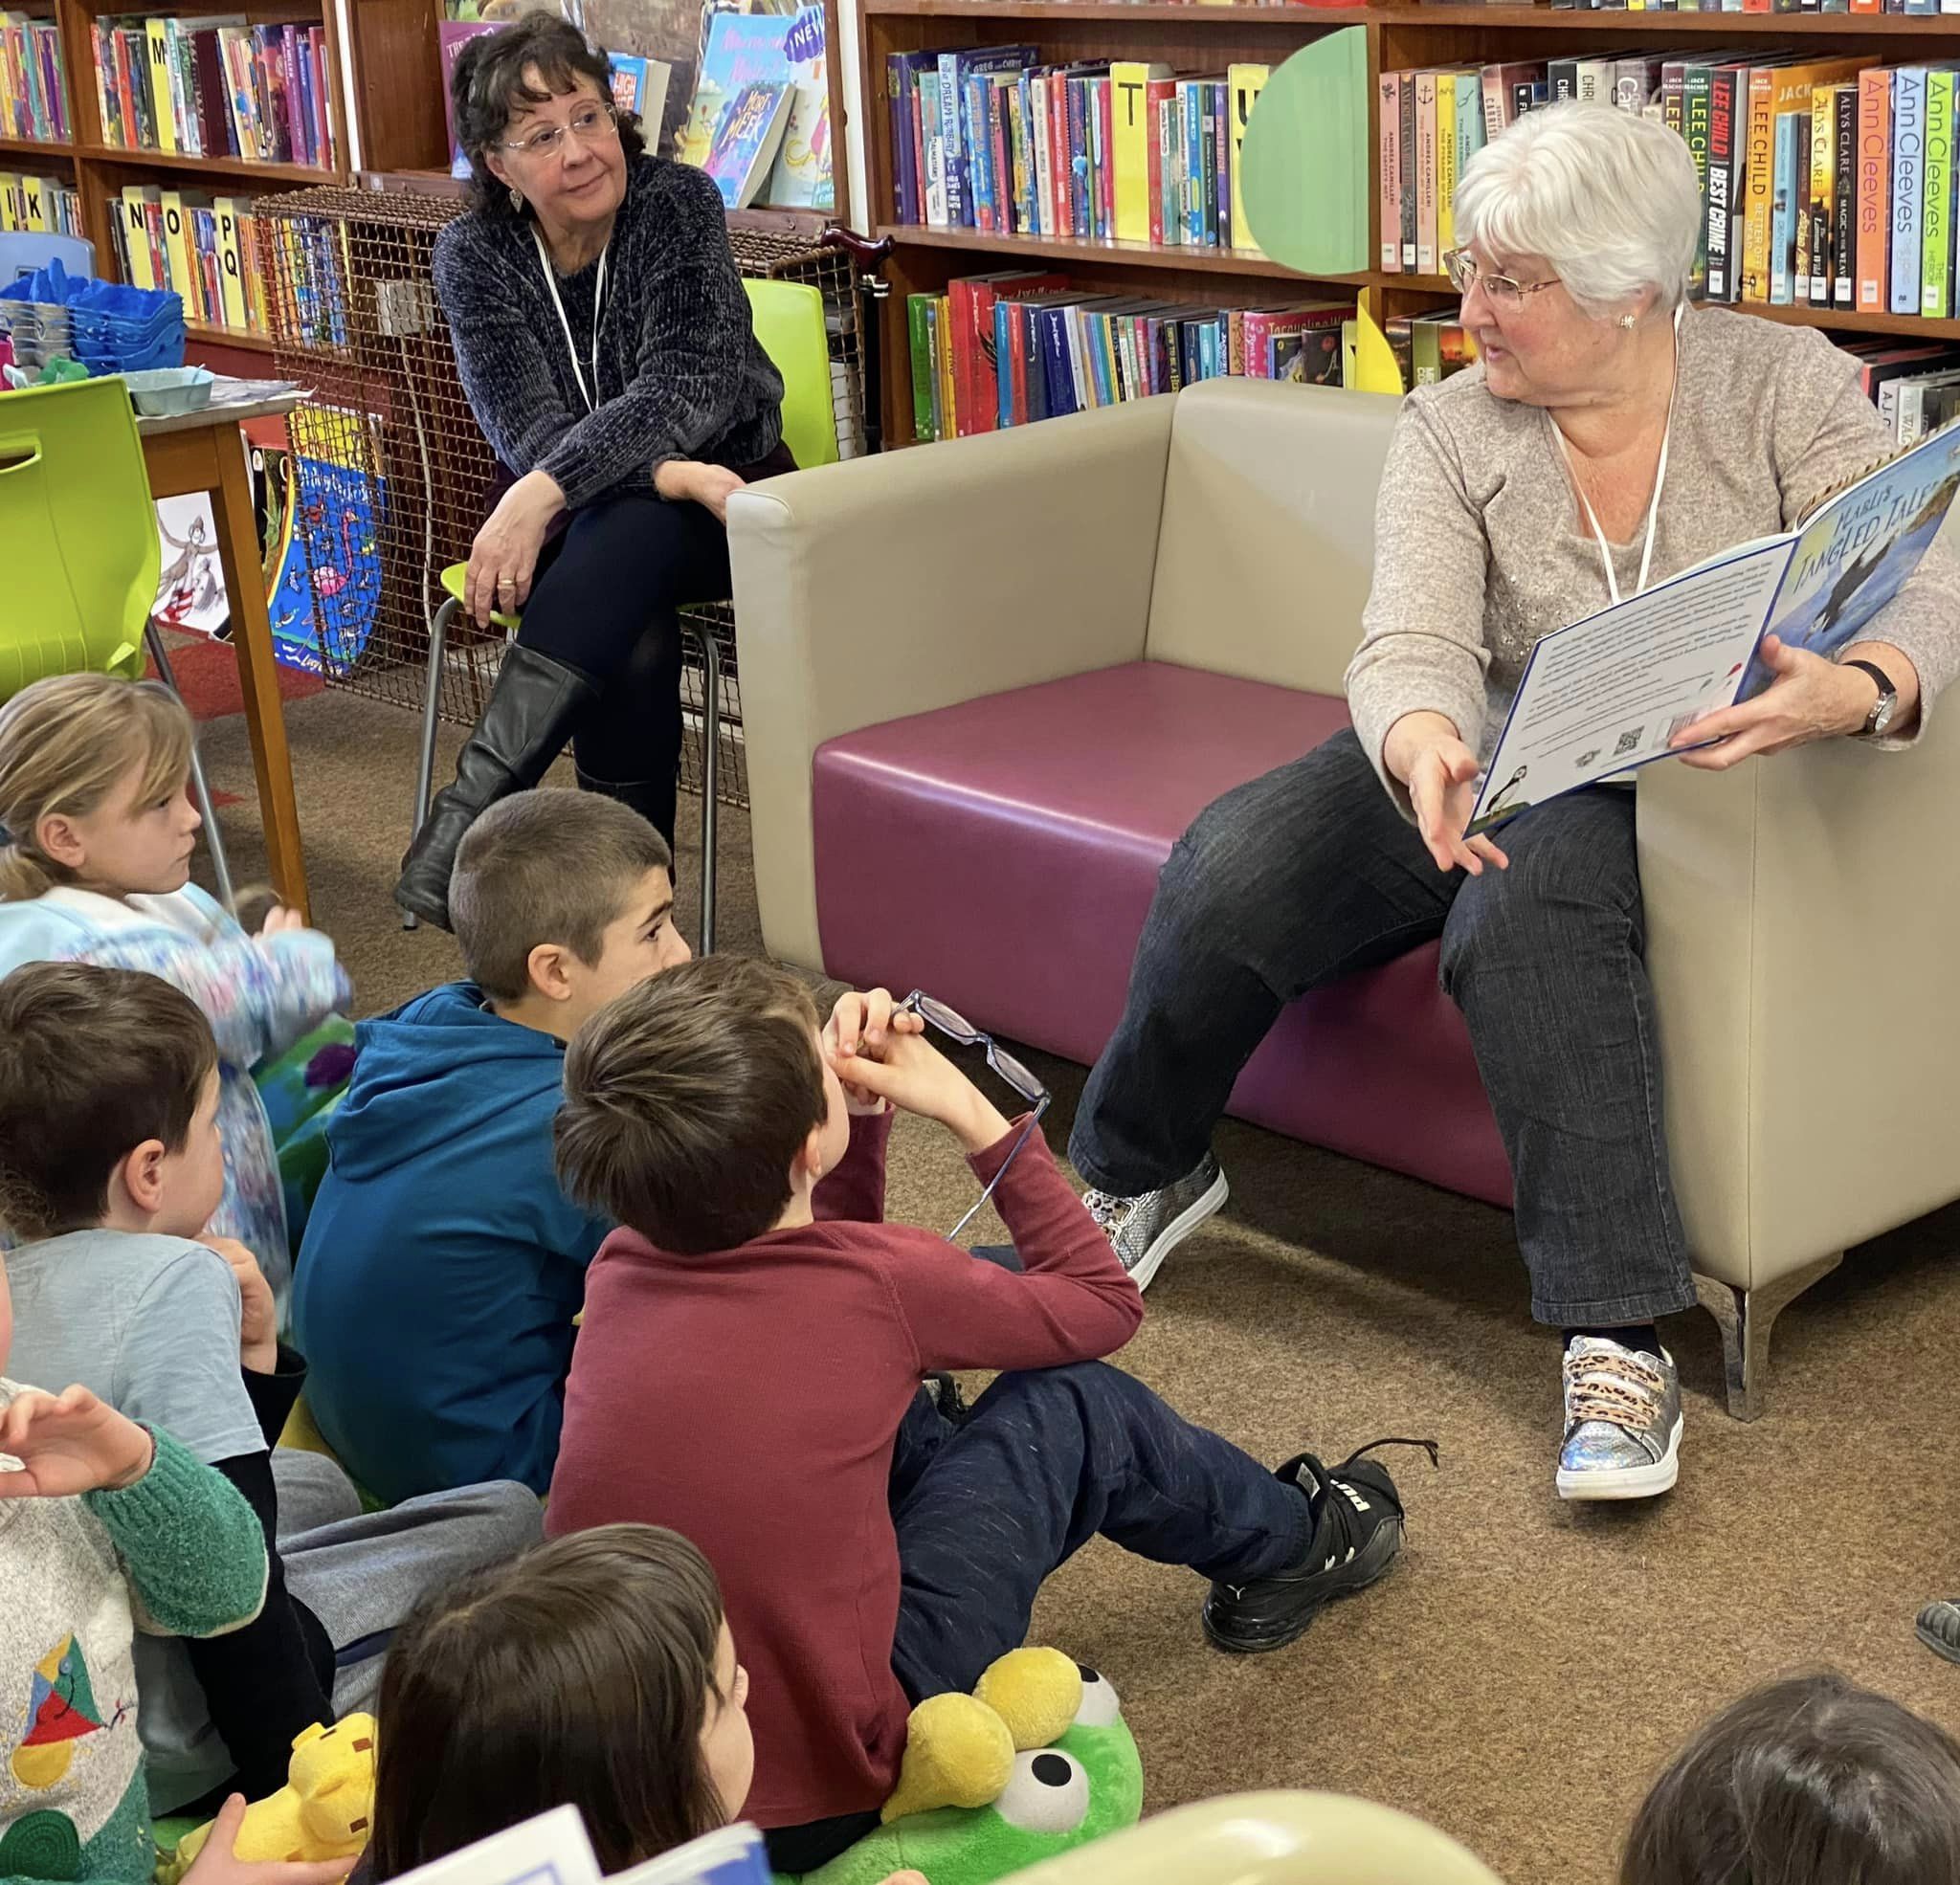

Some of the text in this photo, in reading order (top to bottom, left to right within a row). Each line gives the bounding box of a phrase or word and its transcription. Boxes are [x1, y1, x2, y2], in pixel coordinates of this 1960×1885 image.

[152, 37, 166, 65] M
[794, 20, 824, 48] NEW
[941, 82, 952, 114] DREAM
[1118, 82, 1143, 126] T
[1557, 78, 1570, 100] CHR
[1582, 75, 1594, 100] CHRI
[1617, 77, 1638, 113] Car
[1779, 83, 1812, 102] JACK
[1666, 96, 1681, 131] LEE
[1691, 99, 1706, 132] LEE
[1711, 79, 1730, 155] LEE CHILD
[1752, 101, 1769, 195] LEE CHILD
[1813, 98, 1828, 188] ALYS CLARE
[1839, 96, 1851, 174] ALYS CLARE
[1862, 79, 1884, 233] Ann Cleeves
[1897, 77, 1920, 233] Ann Cleeves
[1926, 80, 1949, 237] Ann Cleeves
[1709, 166, 1727, 208] BEST
[28, 193, 42, 219] K
[130, 203, 144, 229] N
[167, 209, 180, 234] O
[221, 215, 232, 241] P
[1708, 208, 1726, 255] CRIME
[1754, 203, 1764, 245] BETTER
[225, 250, 238, 277] Q
[1927, 251, 1936, 286] HERON
[1793, 515, 1882, 594] TANGLED
